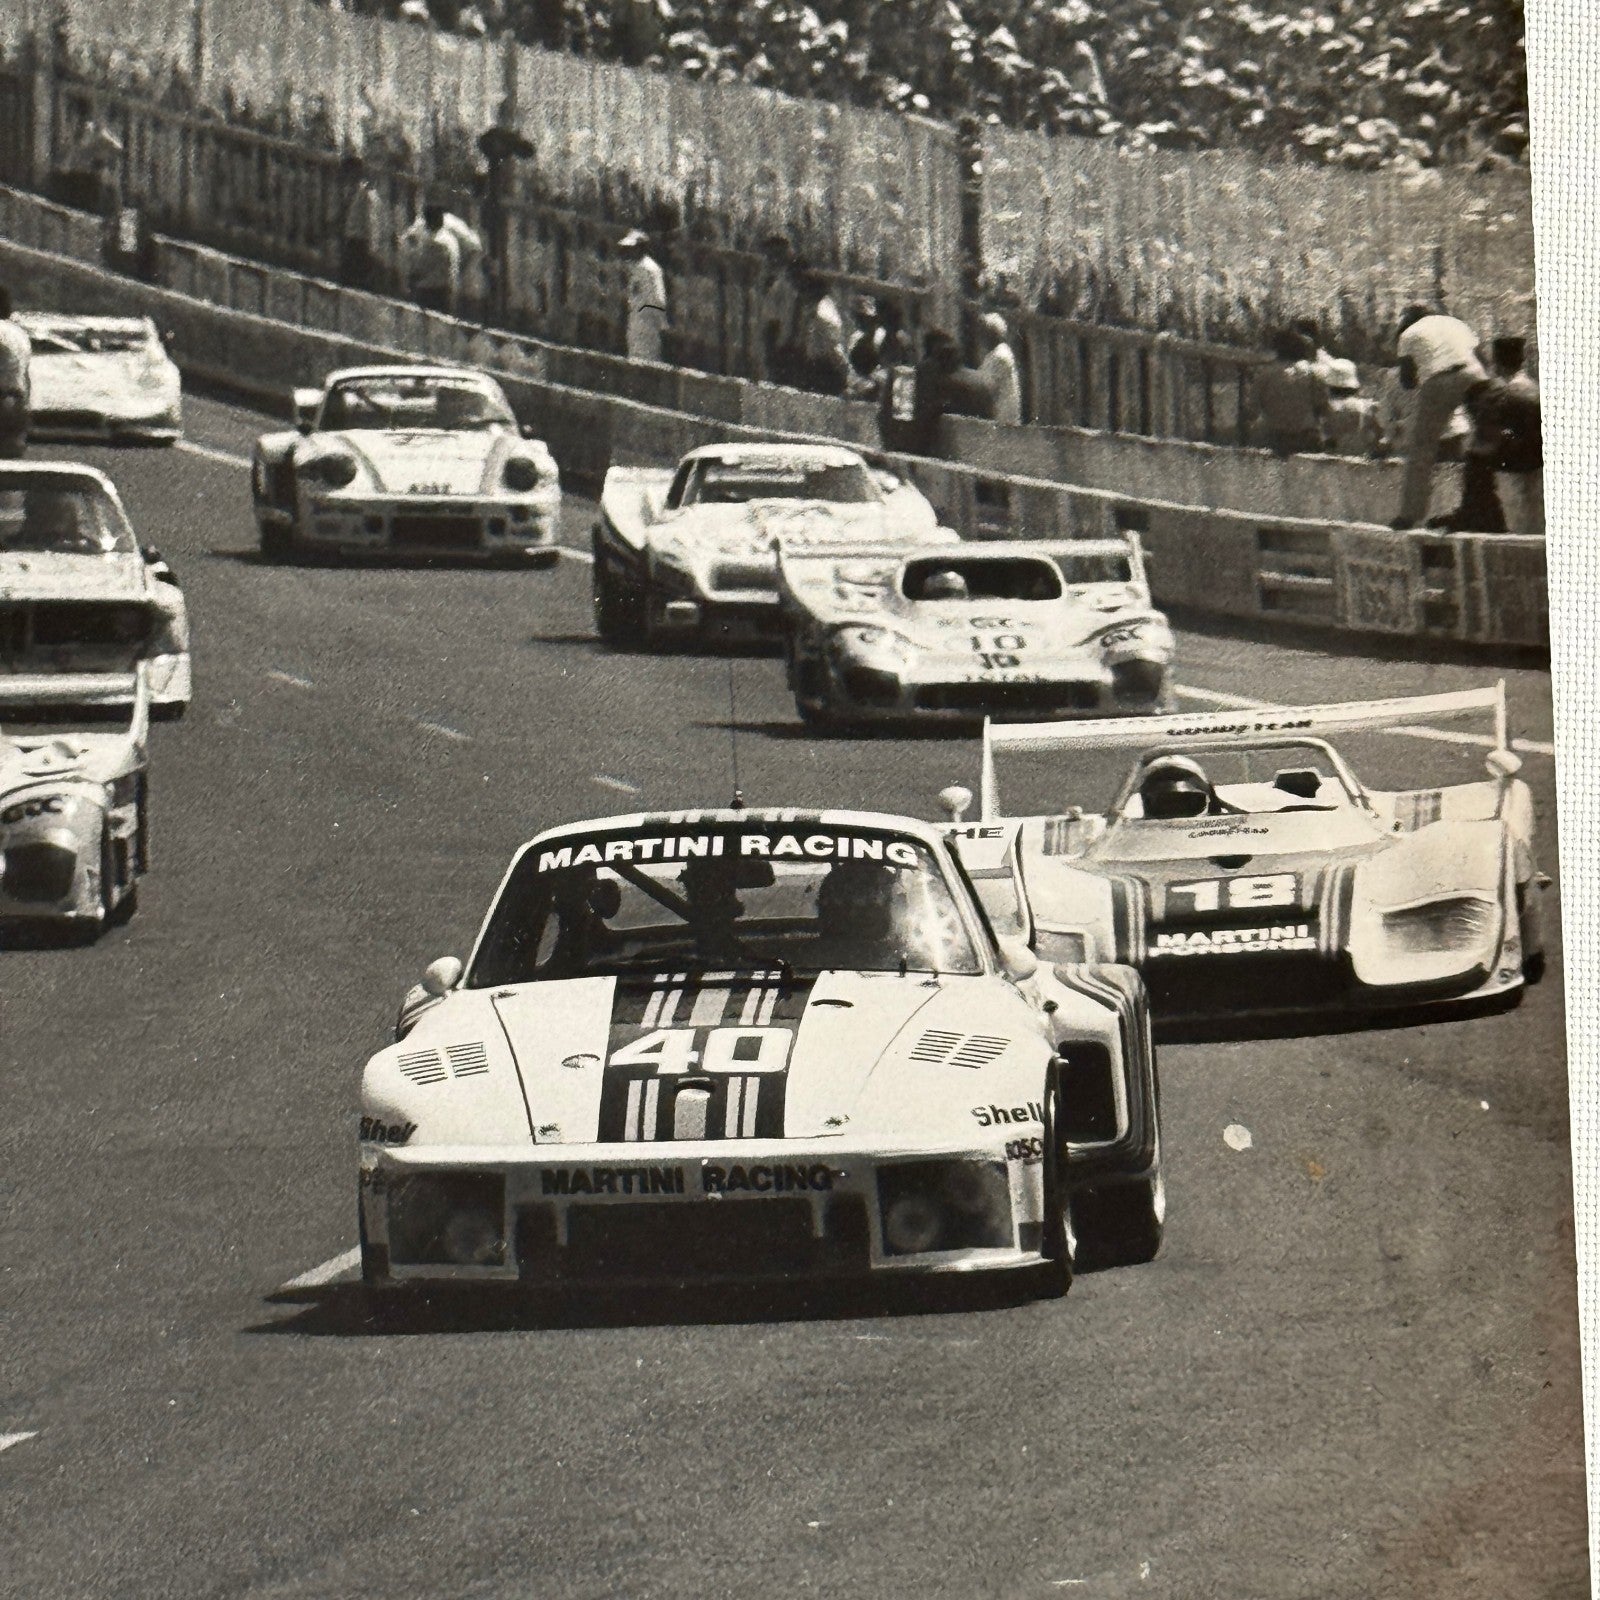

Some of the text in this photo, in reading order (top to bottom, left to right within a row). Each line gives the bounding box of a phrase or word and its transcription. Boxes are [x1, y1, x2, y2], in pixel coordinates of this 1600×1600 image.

[970, 635, 1027, 652] 10
[538, 834, 920, 873] MARTINI RACING
[1170, 873, 1297, 912] 18
[1157, 924, 1309, 947] MARTINI
[608, 1027, 794, 1075] 40
[970, 1101, 1044, 1127] Shell
[541, 1162, 833, 1195] MARTINI RACING
